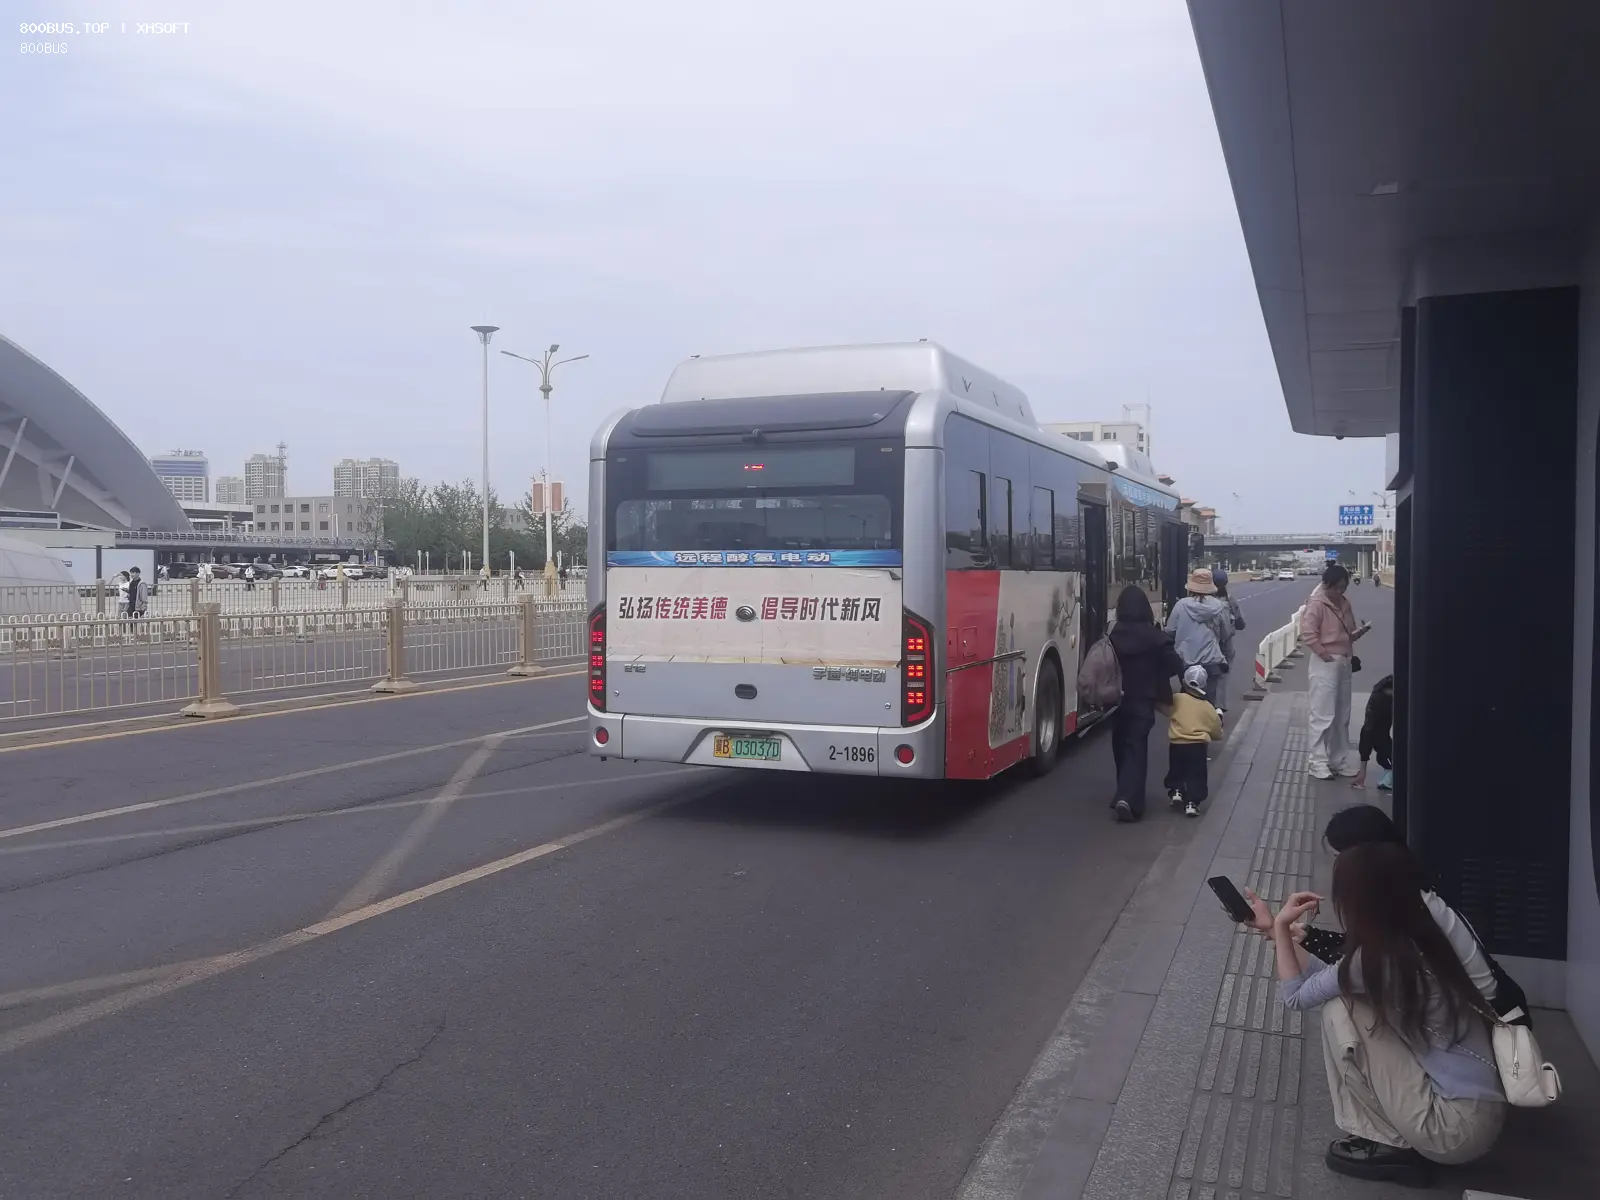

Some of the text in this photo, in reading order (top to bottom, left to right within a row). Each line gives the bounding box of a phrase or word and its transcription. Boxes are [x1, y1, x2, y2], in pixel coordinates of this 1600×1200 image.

[674, 551, 831, 565] 远程醇氢电动
[618, 595, 882, 622] 弘扬传统美德 倡导时代新风
[828, 745, 875, 763] 2-1896
